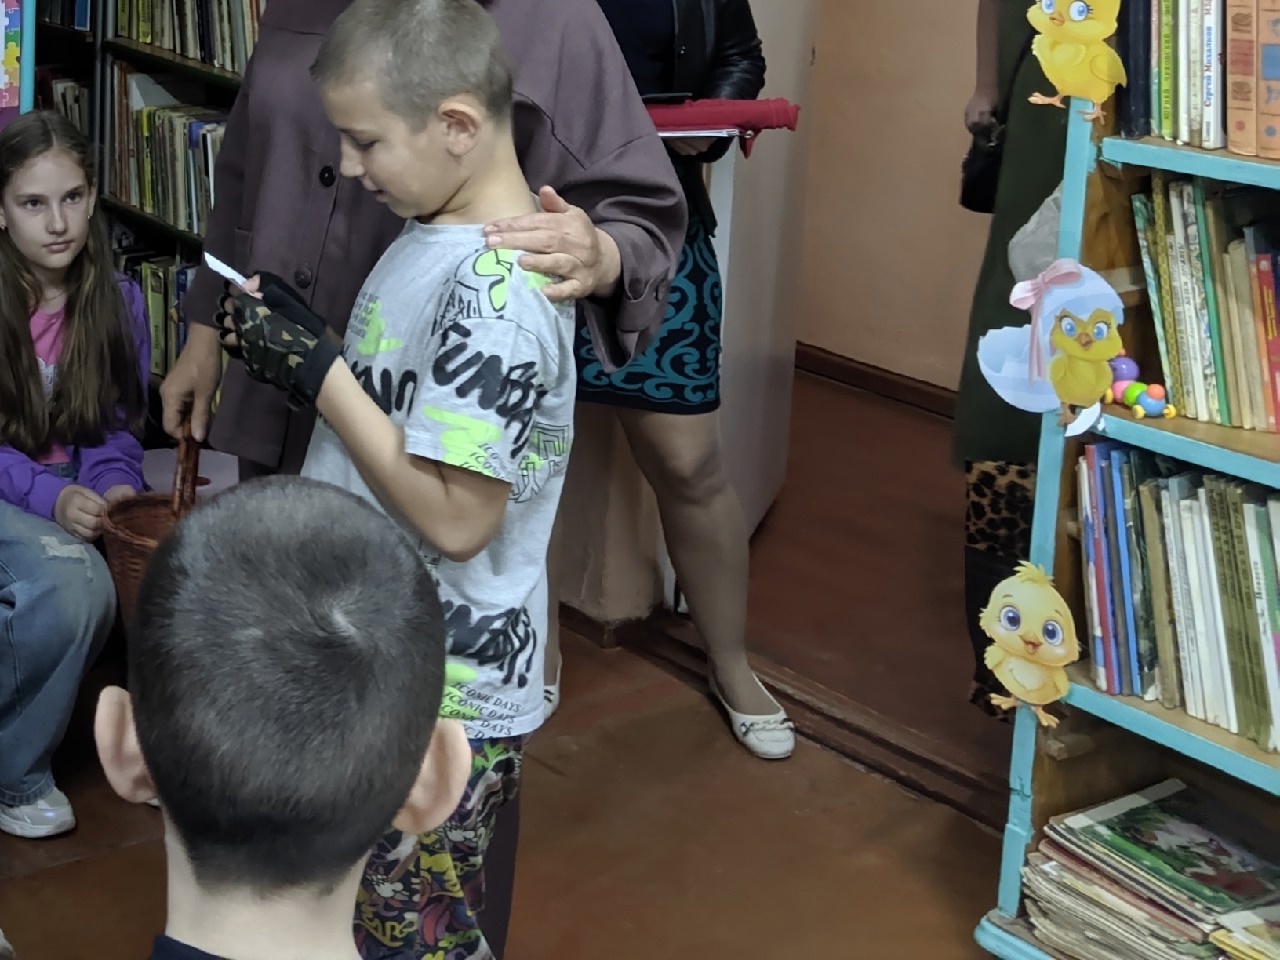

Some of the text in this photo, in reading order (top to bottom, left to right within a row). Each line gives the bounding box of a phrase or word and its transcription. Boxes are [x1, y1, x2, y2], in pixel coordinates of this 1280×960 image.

[1204, 25, 1213, 108] Сергей Михалков
[493, 697, 522, 713] DAYS
[480, 718, 514, 736] DAYS
